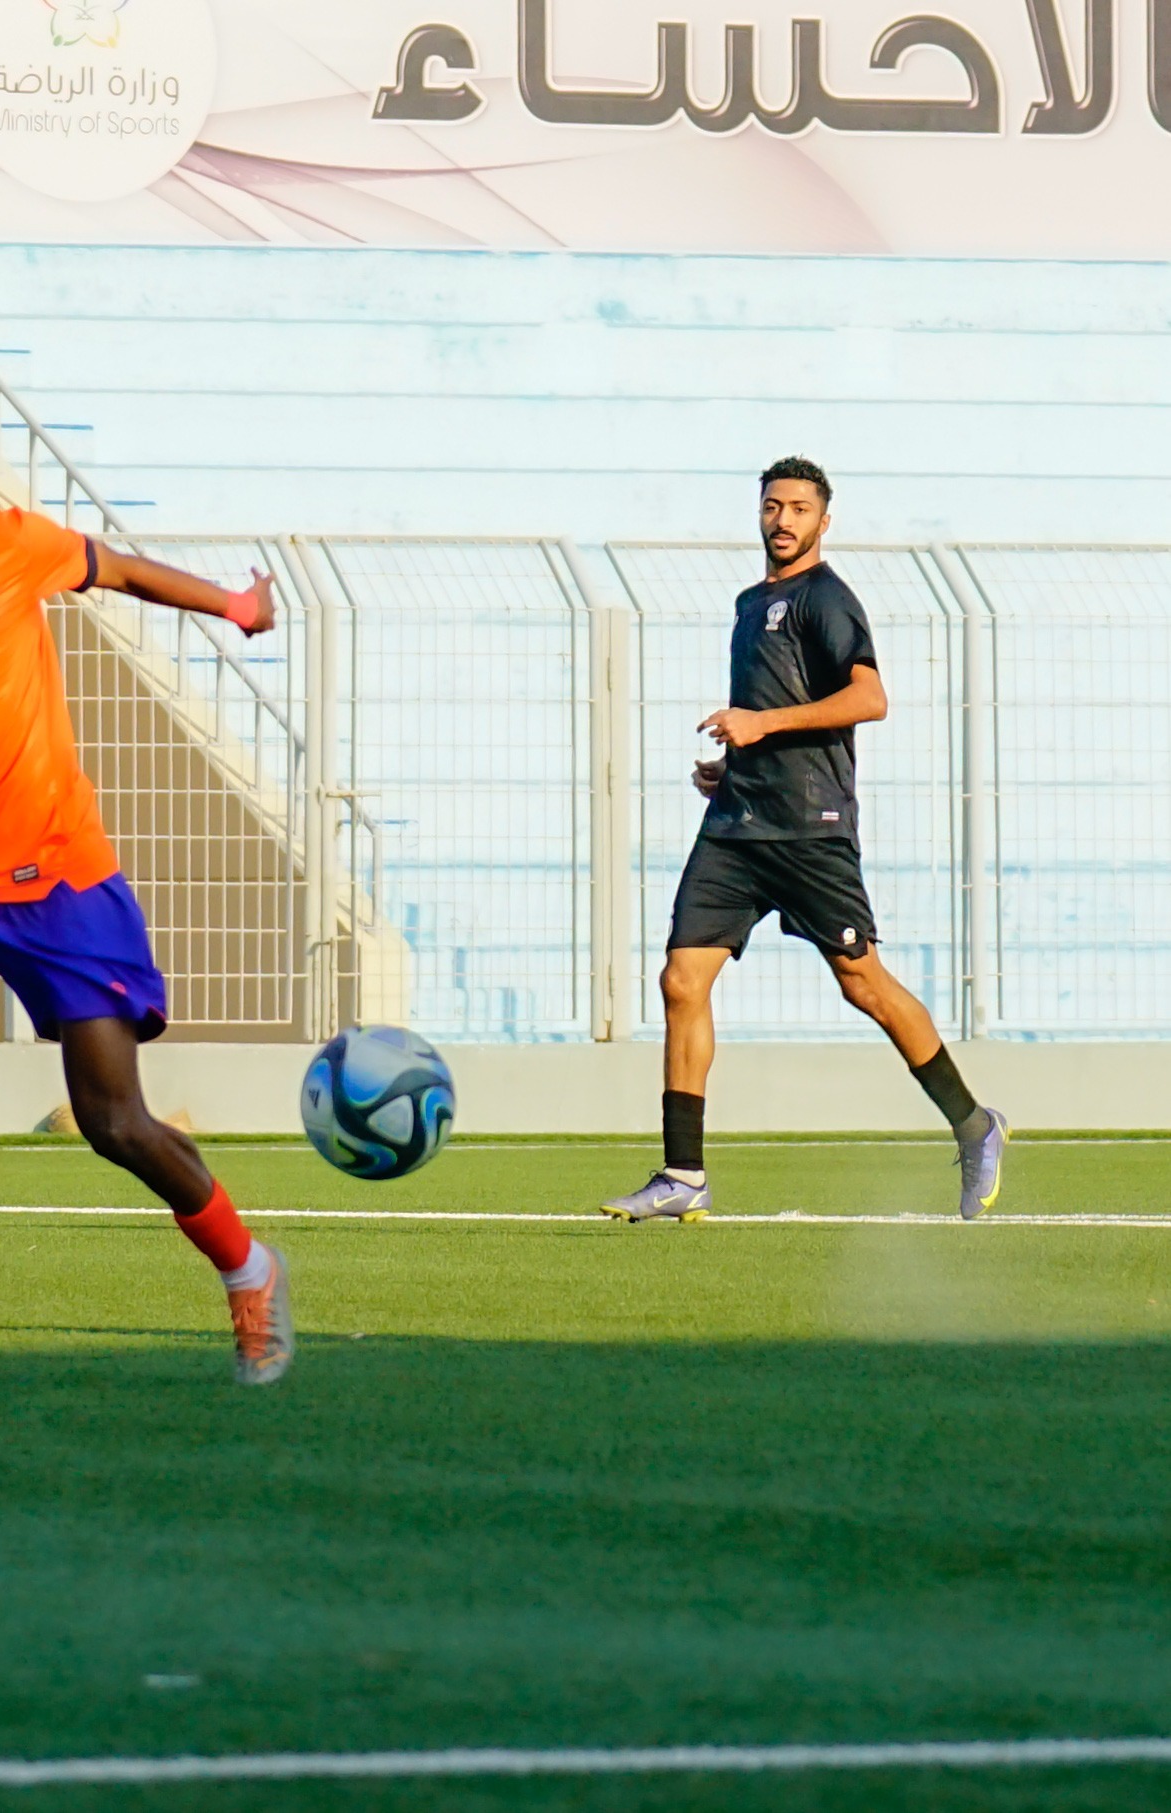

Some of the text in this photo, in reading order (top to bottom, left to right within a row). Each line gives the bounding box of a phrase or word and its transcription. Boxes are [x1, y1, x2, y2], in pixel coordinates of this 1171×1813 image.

[108, 66, 180, 106] وزارة
[78, 111, 102, 134] of
[107, 111, 180, 139] Sports
